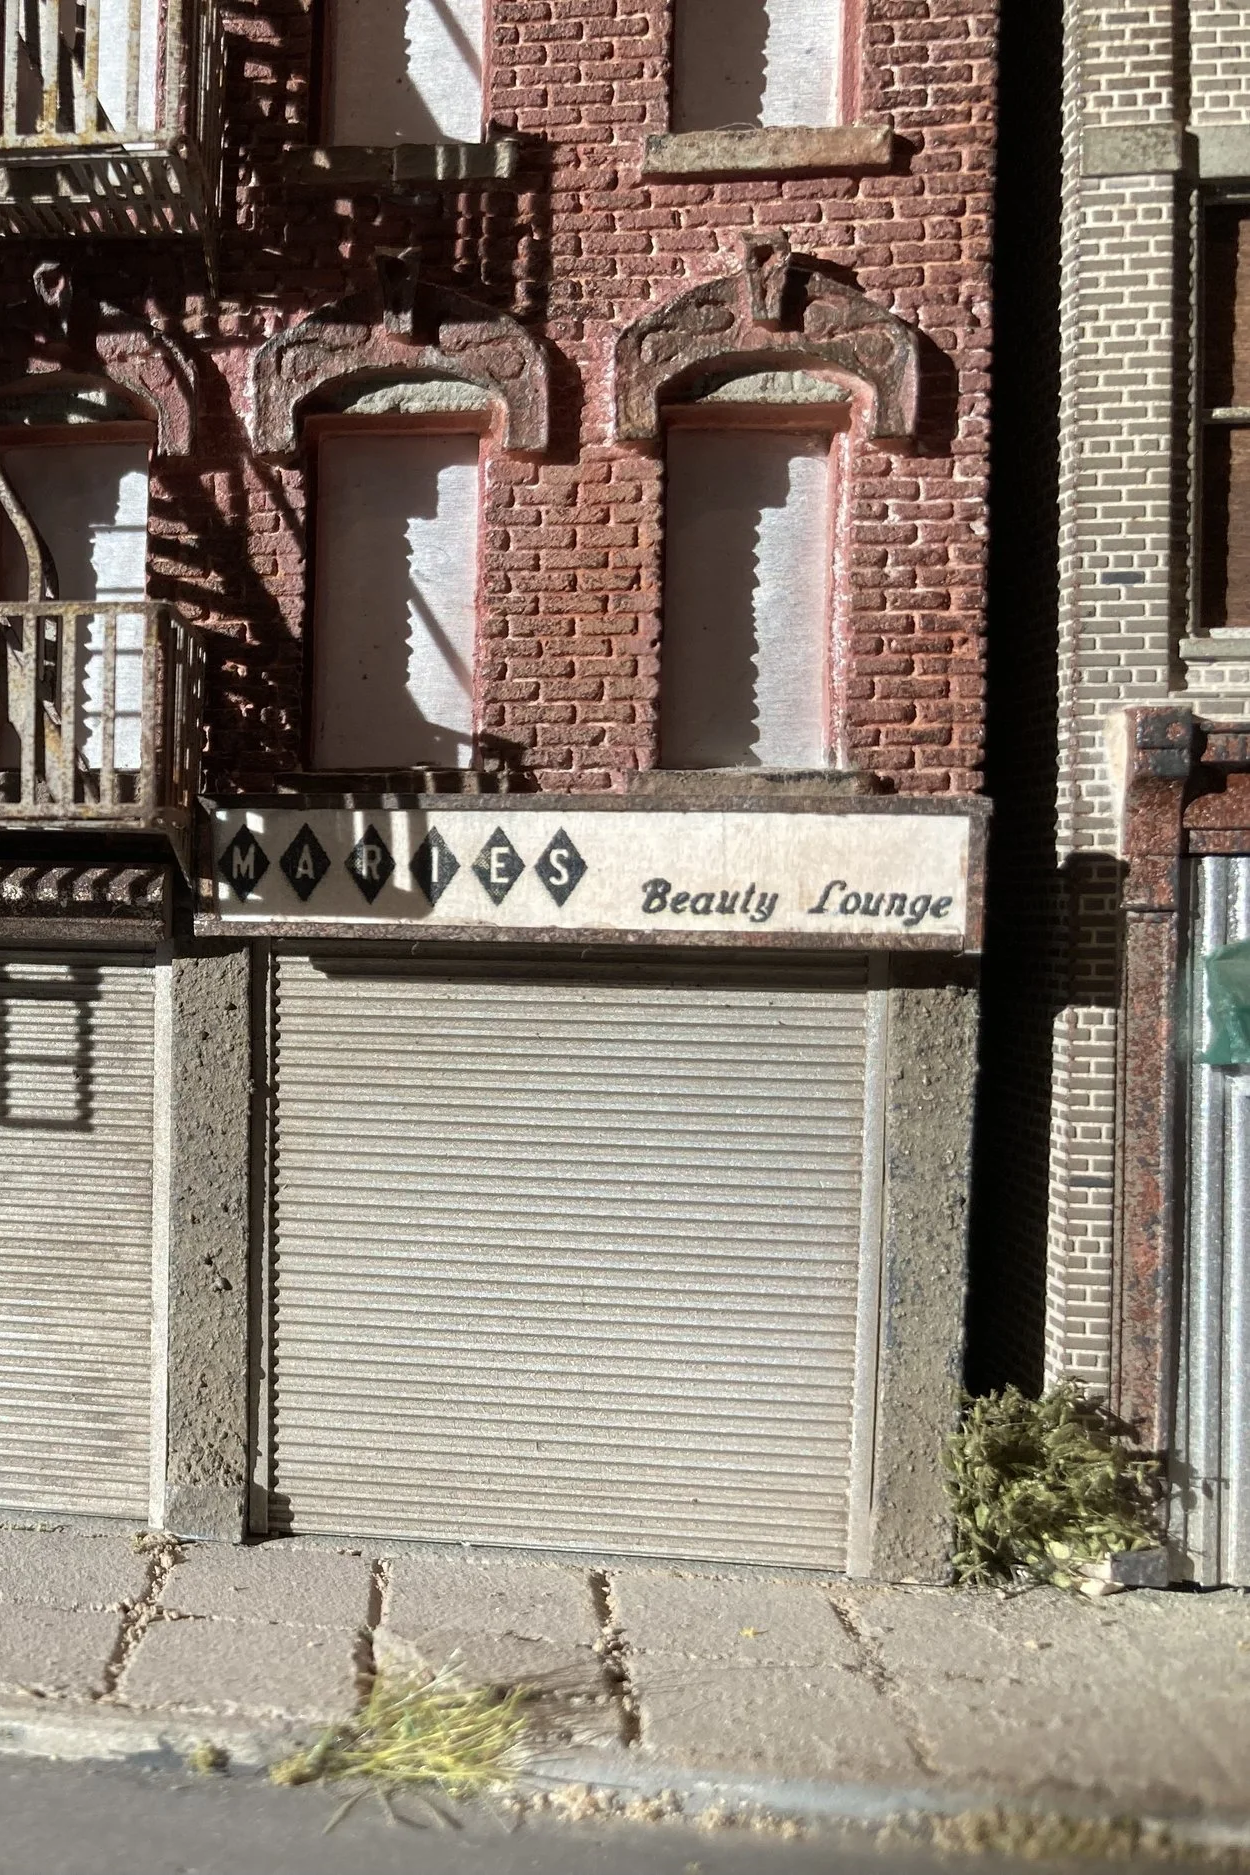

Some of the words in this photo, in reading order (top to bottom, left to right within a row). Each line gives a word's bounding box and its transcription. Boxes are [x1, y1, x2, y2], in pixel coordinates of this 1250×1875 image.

[231, 841, 571, 888] MARIES
[642, 877, 779, 923] Beauty
[807, 879, 954, 927] Lounge
